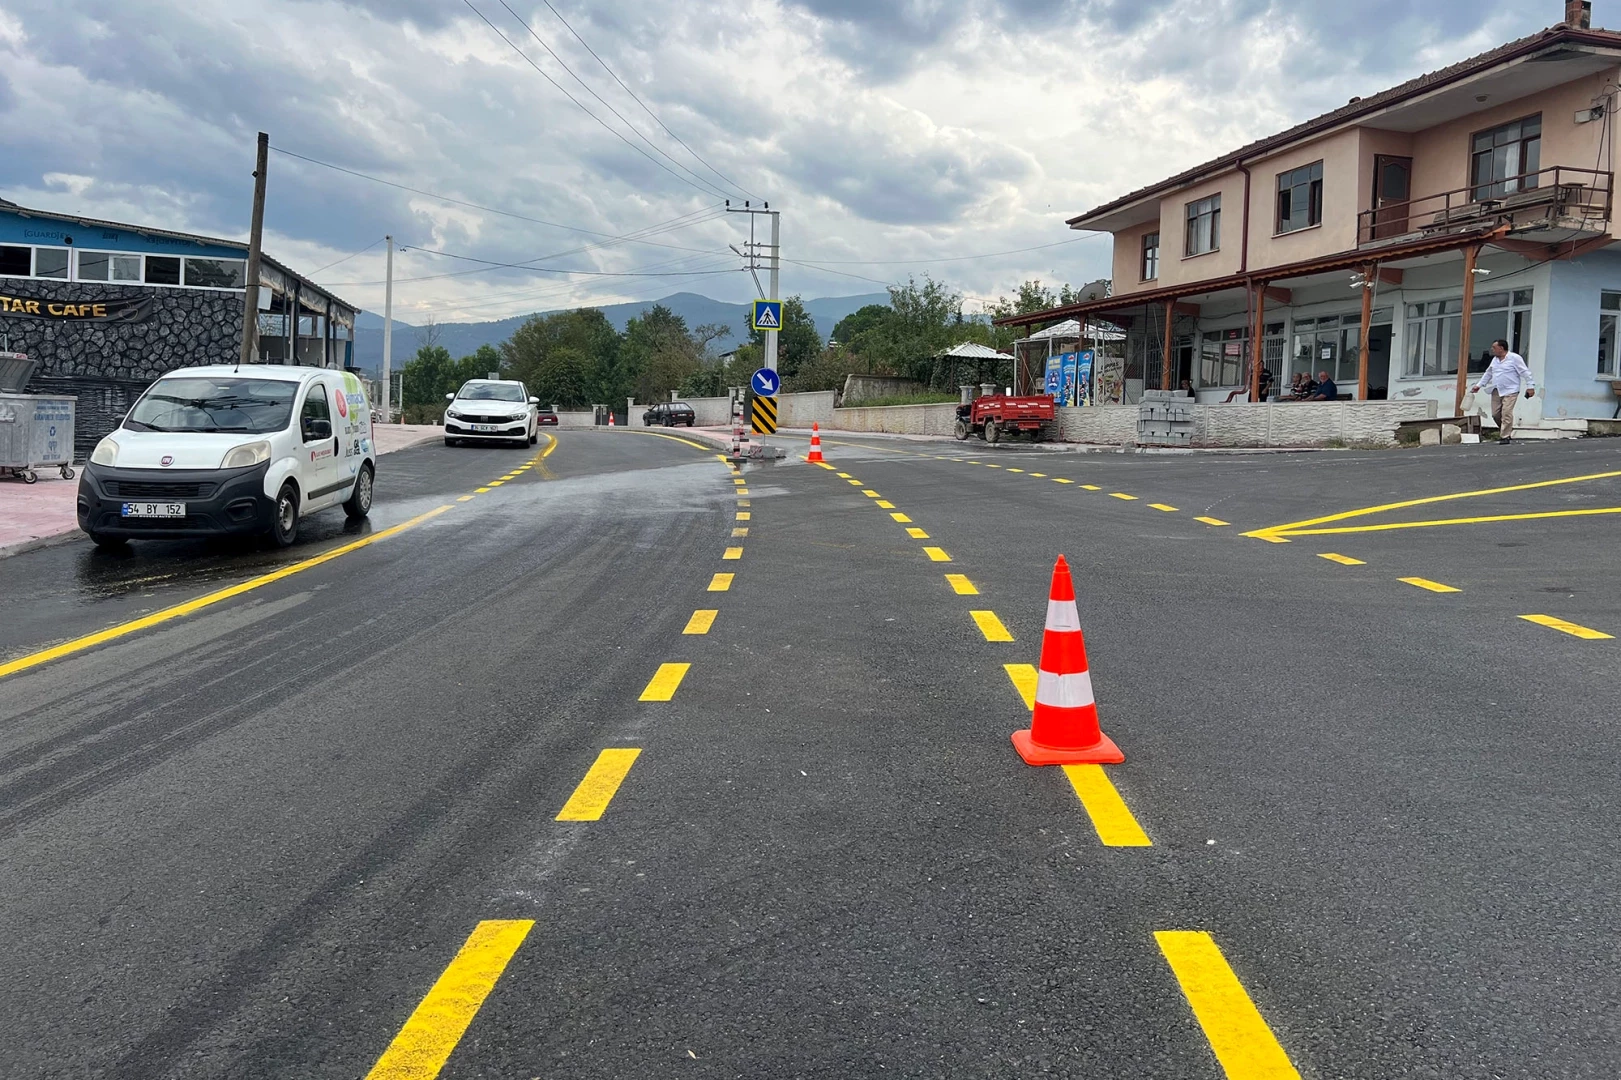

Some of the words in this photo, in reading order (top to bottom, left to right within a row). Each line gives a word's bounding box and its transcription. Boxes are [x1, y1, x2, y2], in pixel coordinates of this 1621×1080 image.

[48, 303, 108, 317] CAFE
[128, 504, 139, 514] 54
[146, 504, 158, 514] BY
[166, 504, 181, 514] 152
